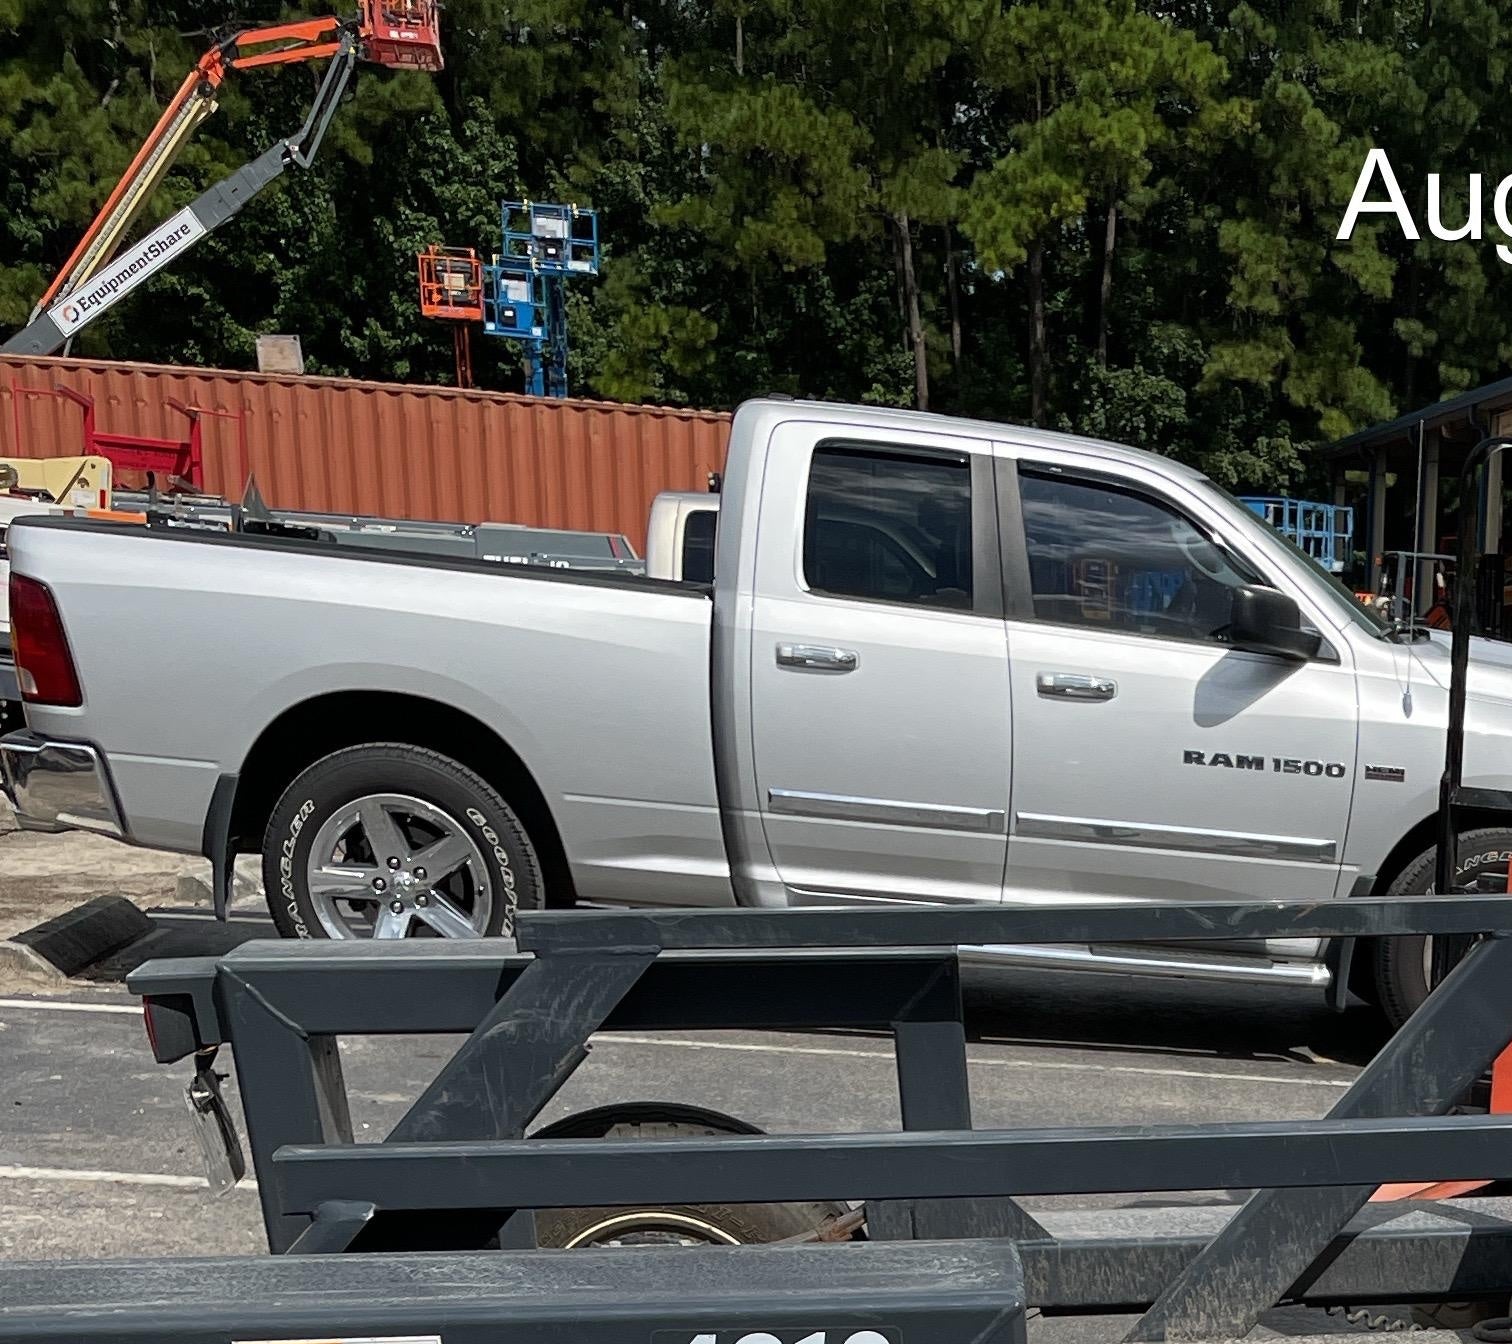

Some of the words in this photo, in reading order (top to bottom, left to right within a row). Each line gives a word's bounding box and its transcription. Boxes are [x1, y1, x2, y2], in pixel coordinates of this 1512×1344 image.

[76, 223, 191, 312] EquipmentShare
[1184, 750, 1265, 770] RAM
[1272, 757, 1346, 778] 1500
